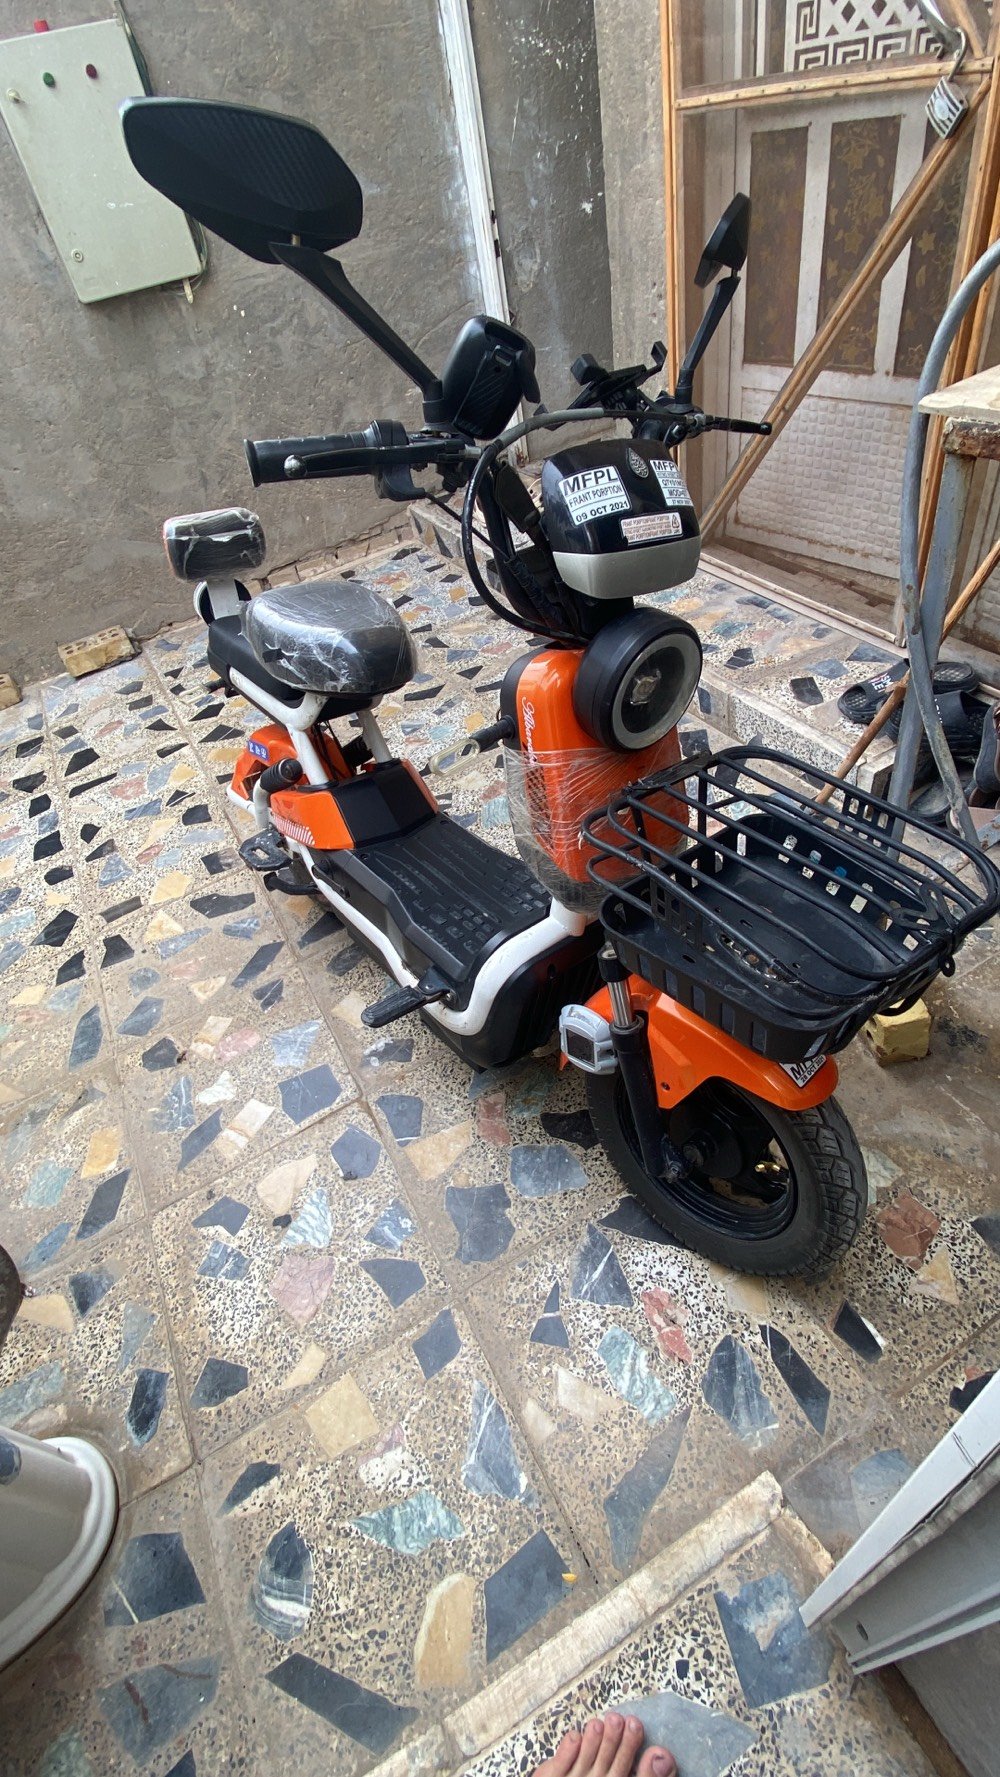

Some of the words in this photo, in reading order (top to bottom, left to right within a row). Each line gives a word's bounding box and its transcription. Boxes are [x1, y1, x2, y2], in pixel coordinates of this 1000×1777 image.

[562, 468, 618, 497] MFPL
[569, 492, 591, 508] FRANT
[575, 513, 588, 523] 09
[590, 506, 608, 517] OCT
[609, 500, 628, 511] 2021
[806, 1065, 817, 1076] OCT
